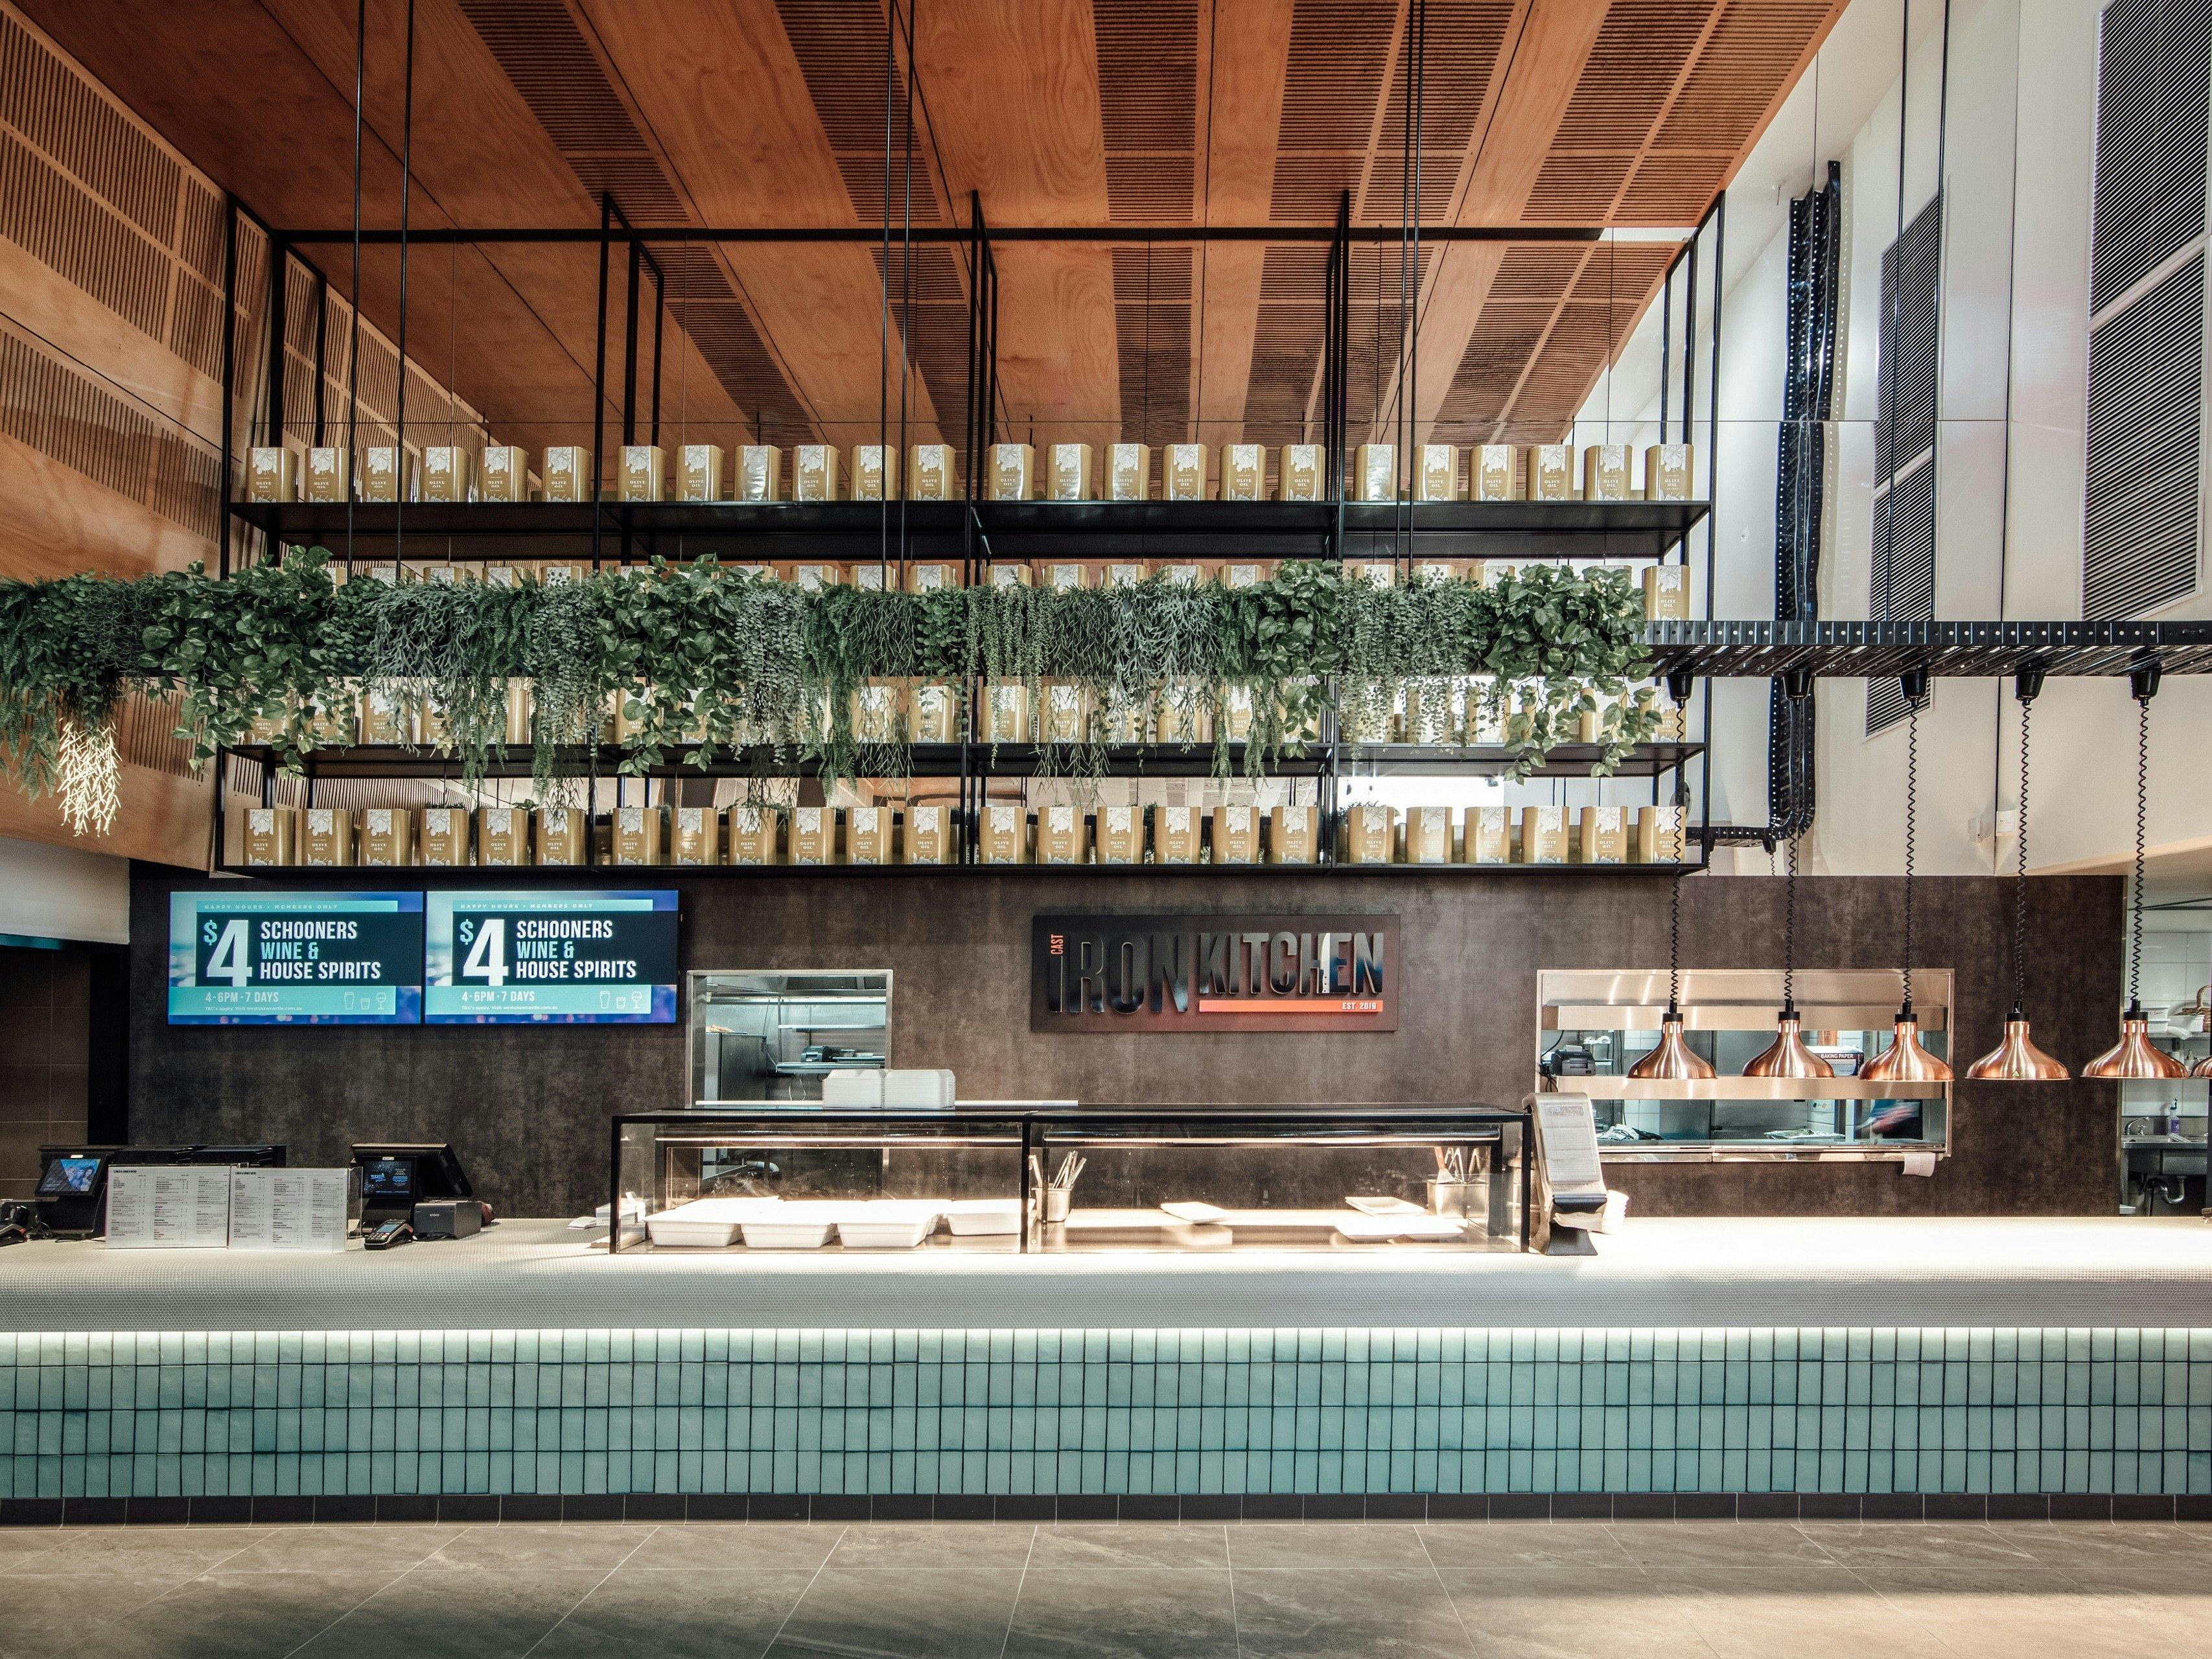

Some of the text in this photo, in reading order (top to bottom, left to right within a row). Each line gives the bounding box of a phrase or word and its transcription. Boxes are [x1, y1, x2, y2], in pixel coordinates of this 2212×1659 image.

[261, 921, 358, 940] SCHOONERS
[516, 920, 614, 938] SCHOONERS
[261, 942, 319, 960] WINE &
[517, 941, 574, 958] WINE &
[1051, 934, 1064, 955] CAST
[260, 962, 381, 979] HOUSE SPIRITS
[516, 960, 636, 979] HOUSE SPIRITS
[1049, 931, 1384, 1014] IRON KITCHEN
[255, 992, 279, 1002] DAYS
[511, 992, 535, 1002] DAYS
